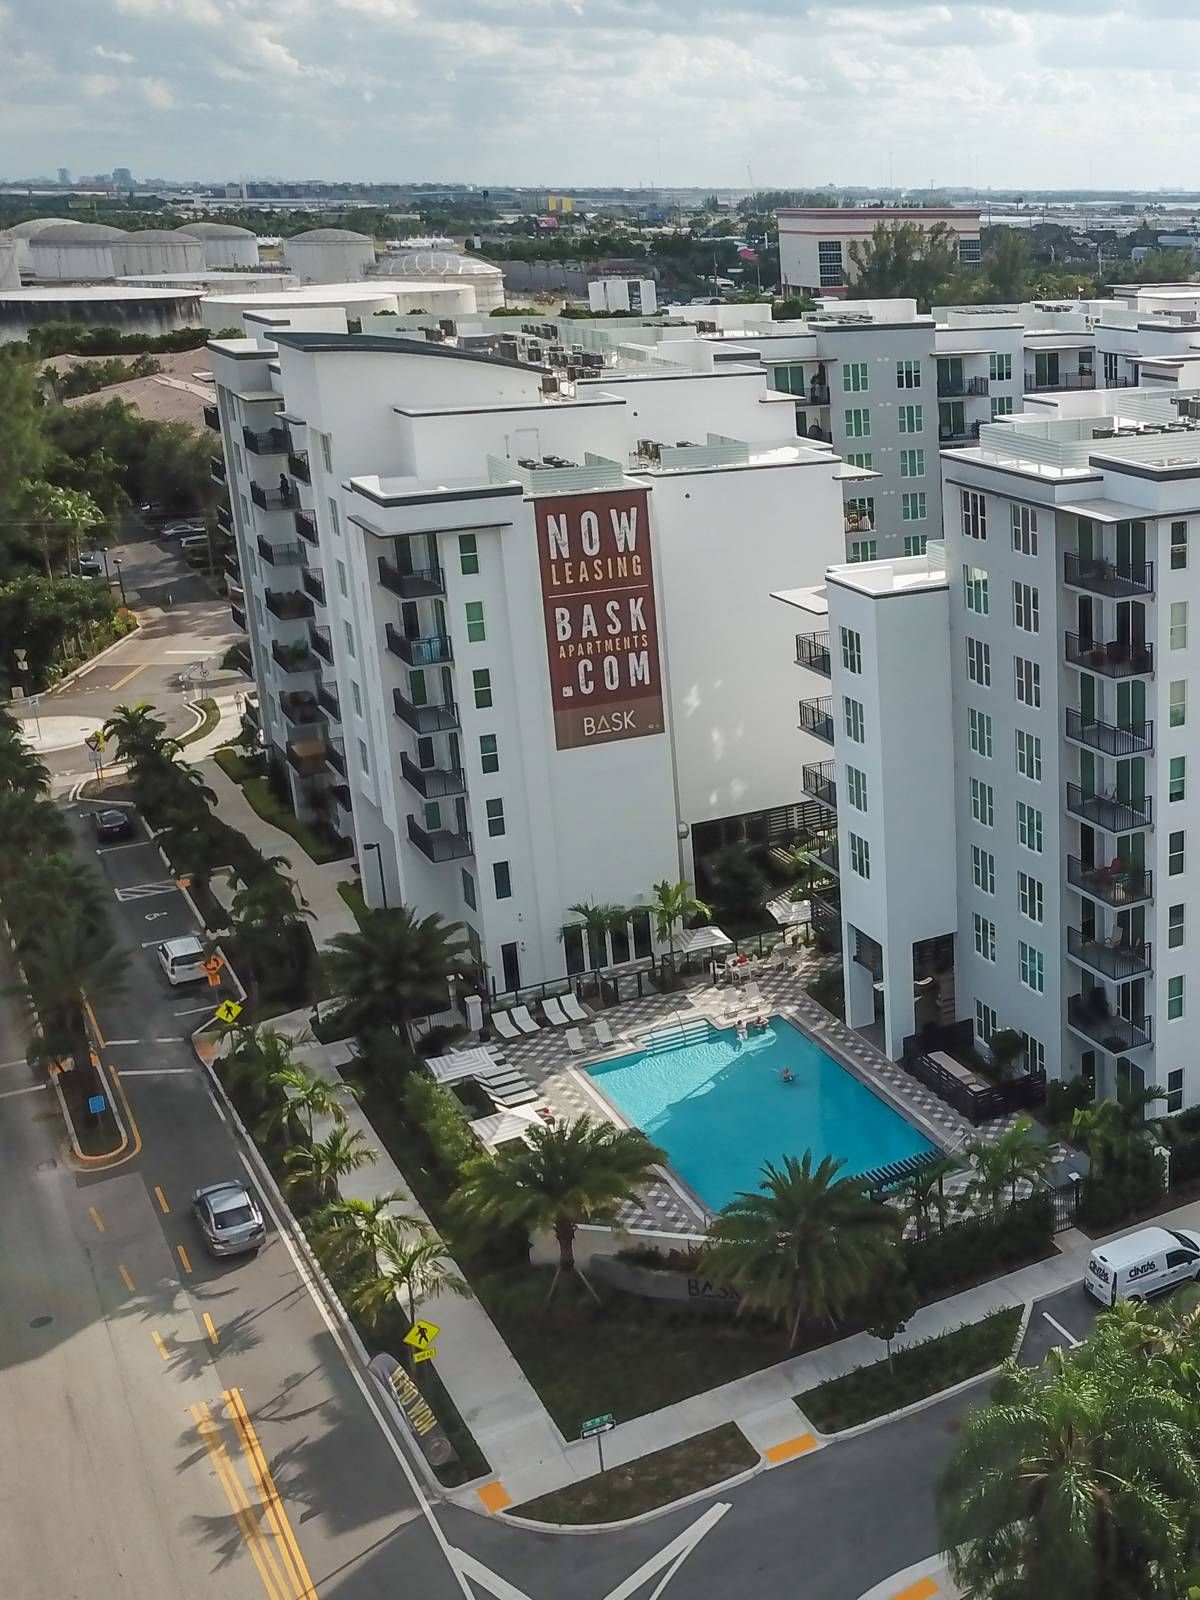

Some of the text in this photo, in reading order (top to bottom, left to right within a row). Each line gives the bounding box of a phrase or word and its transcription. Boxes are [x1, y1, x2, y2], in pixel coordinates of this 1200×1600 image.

[546, 507, 637, 560] NOW
[551, 555, 642, 586] LEASING
[555, 597, 647, 642] BASK
[559, 634, 649, 659] APARTMENTS
[562, 650, 650, 698] .COM
[583, 709, 637, 736] BASK
[1089, 1260, 1110, 1283] CINTAS
[1128, 1260, 1156, 1278] CINTAS
